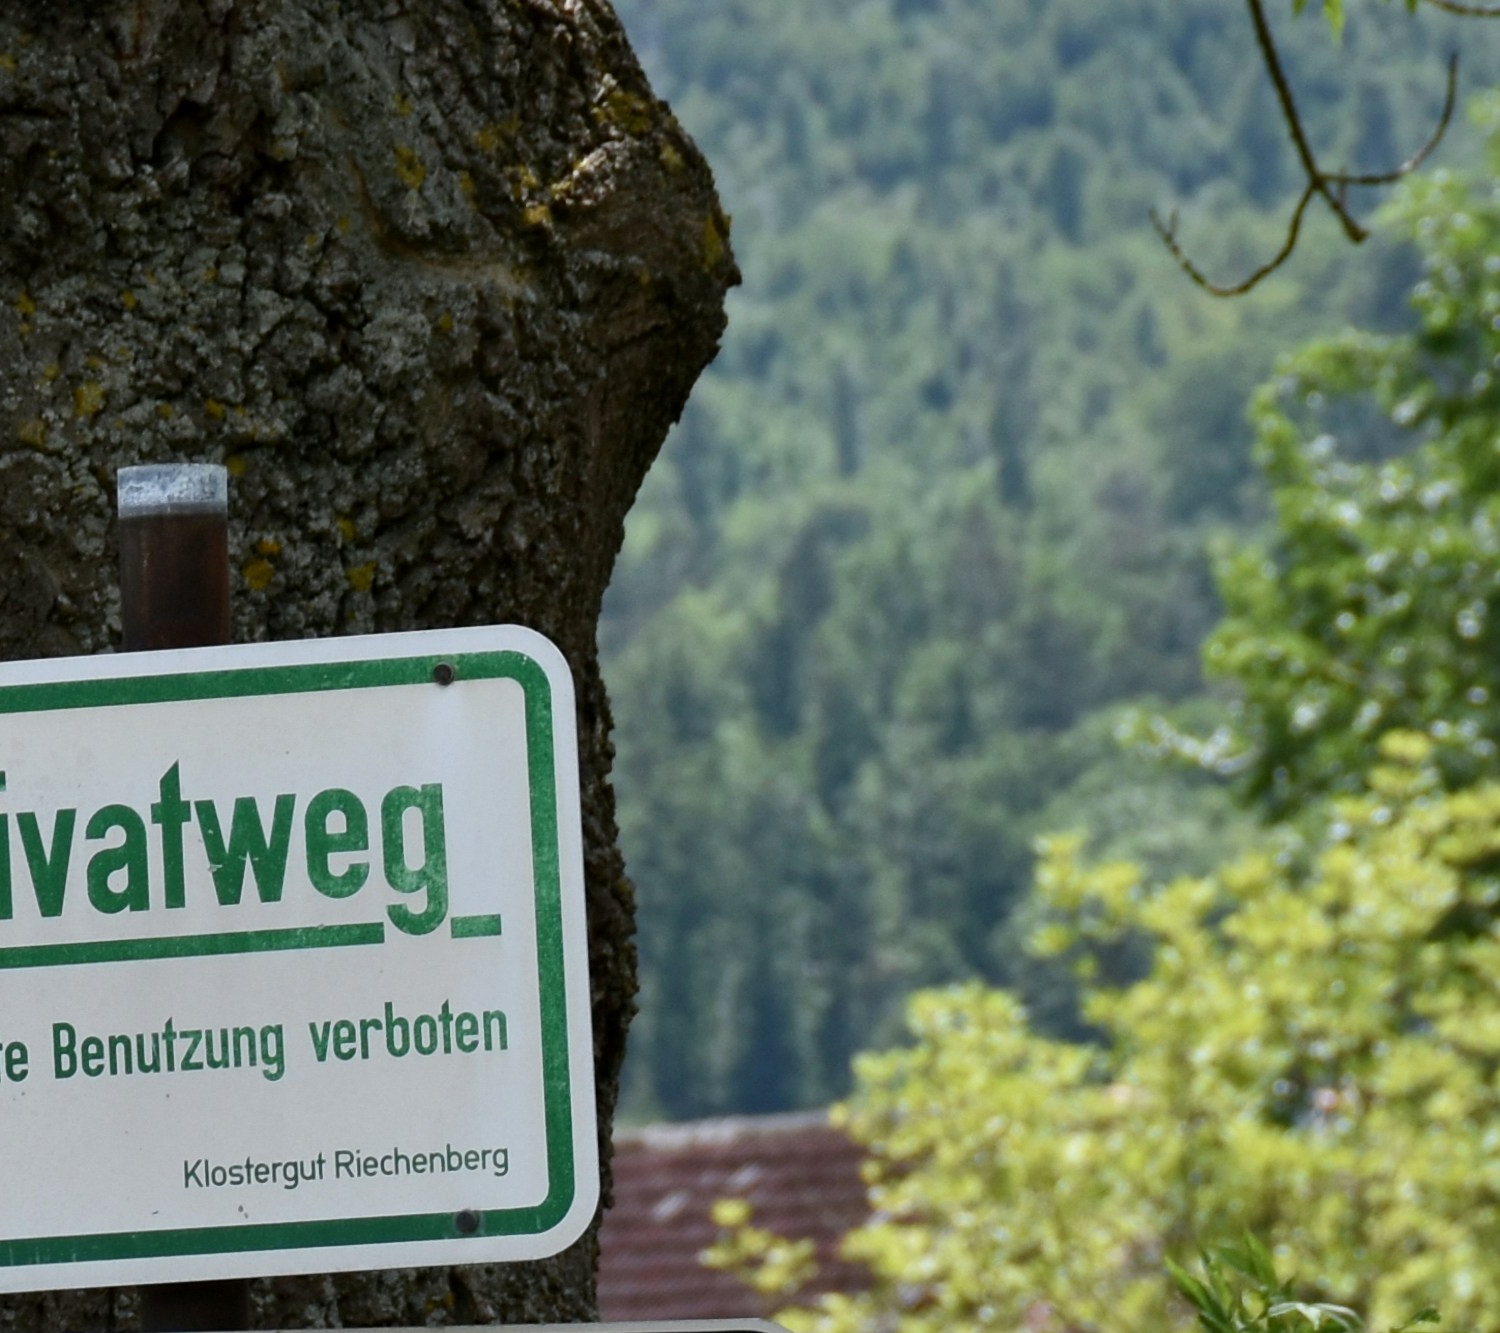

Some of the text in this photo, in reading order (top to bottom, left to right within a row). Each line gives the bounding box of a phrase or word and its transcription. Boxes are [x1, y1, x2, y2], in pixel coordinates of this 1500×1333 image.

[52, 1017, 285, 1082] Benutzung
[308, 999, 508, 1063] verboten
[183, 1143, 509, 1190] Klostergut Riechenberg
